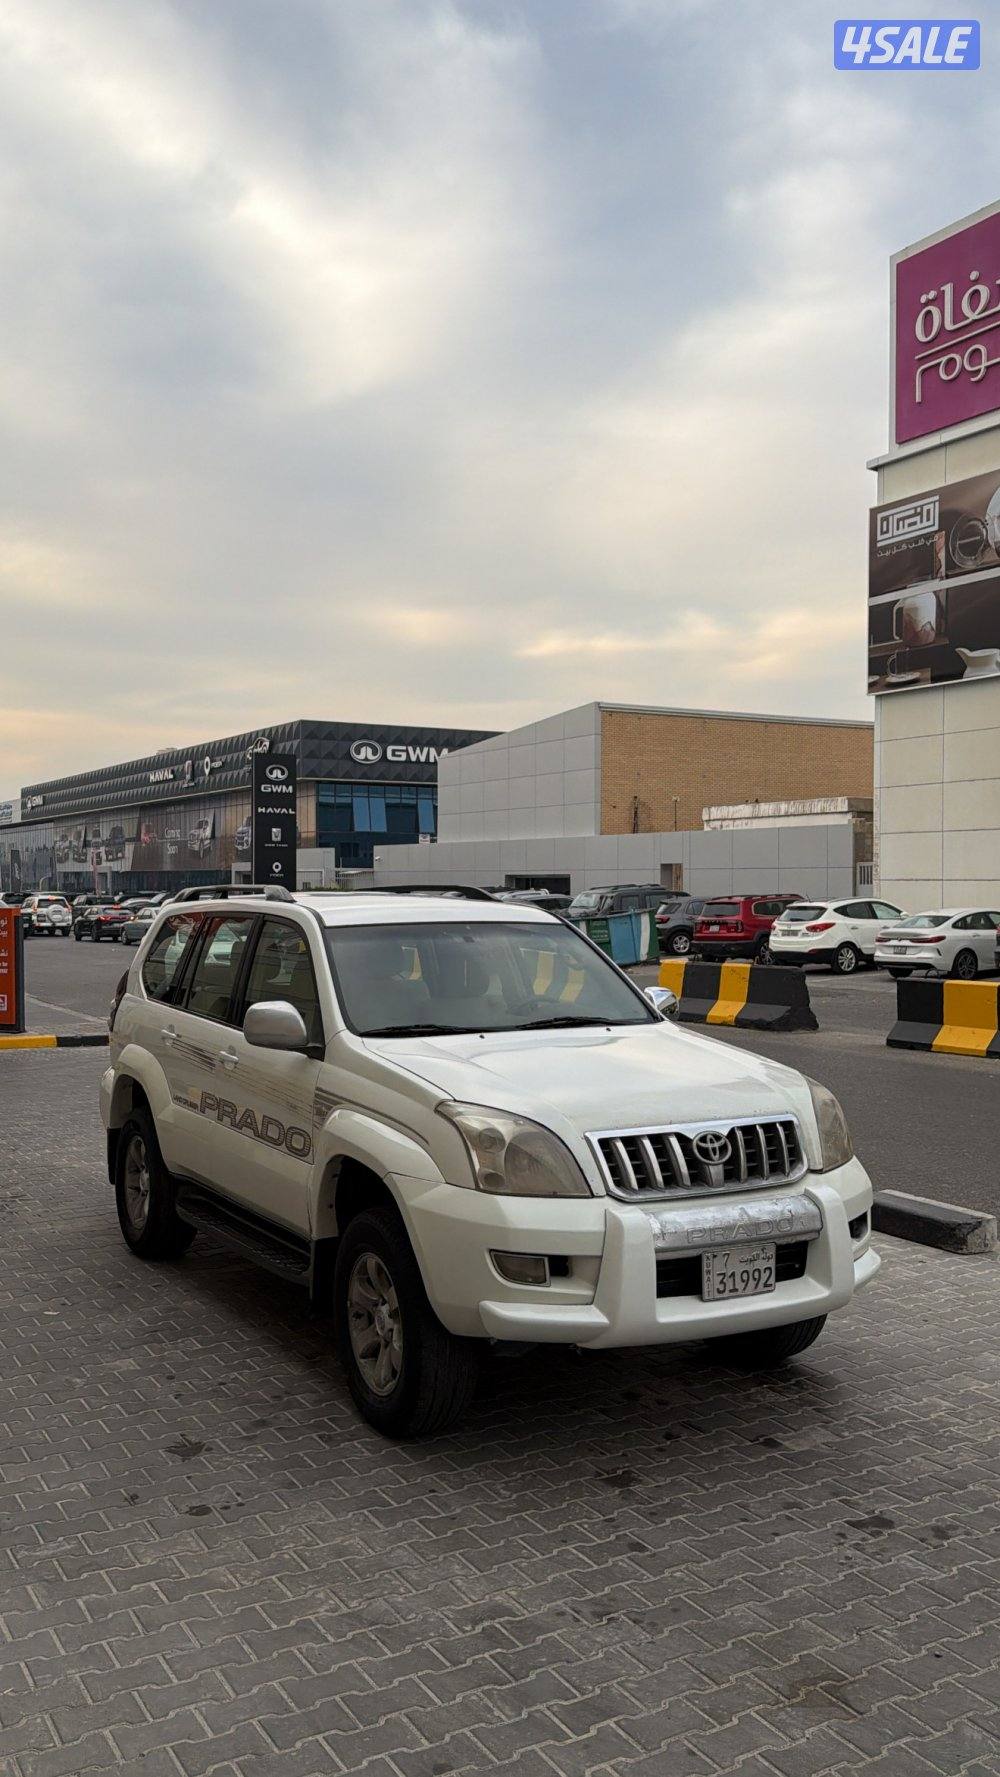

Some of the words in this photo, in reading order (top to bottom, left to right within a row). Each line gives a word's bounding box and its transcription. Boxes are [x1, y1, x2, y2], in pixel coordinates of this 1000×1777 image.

[915, 270, 1000, 343] فاة
[386, 745, 449, 763] GWM
[149, 769, 174, 782] HAVAL
[260, 784, 293, 794] GWM
[257, 806, 296, 815] HAVAL
[199, 1090, 312, 1158] PRADO
[686, 1216, 795, 1244] PRADO
[722, 1252, 730, 1268] 7
[704, 1254, 712, 1297] KUWAIT
[716, 1266, 774, 1295] 31992
